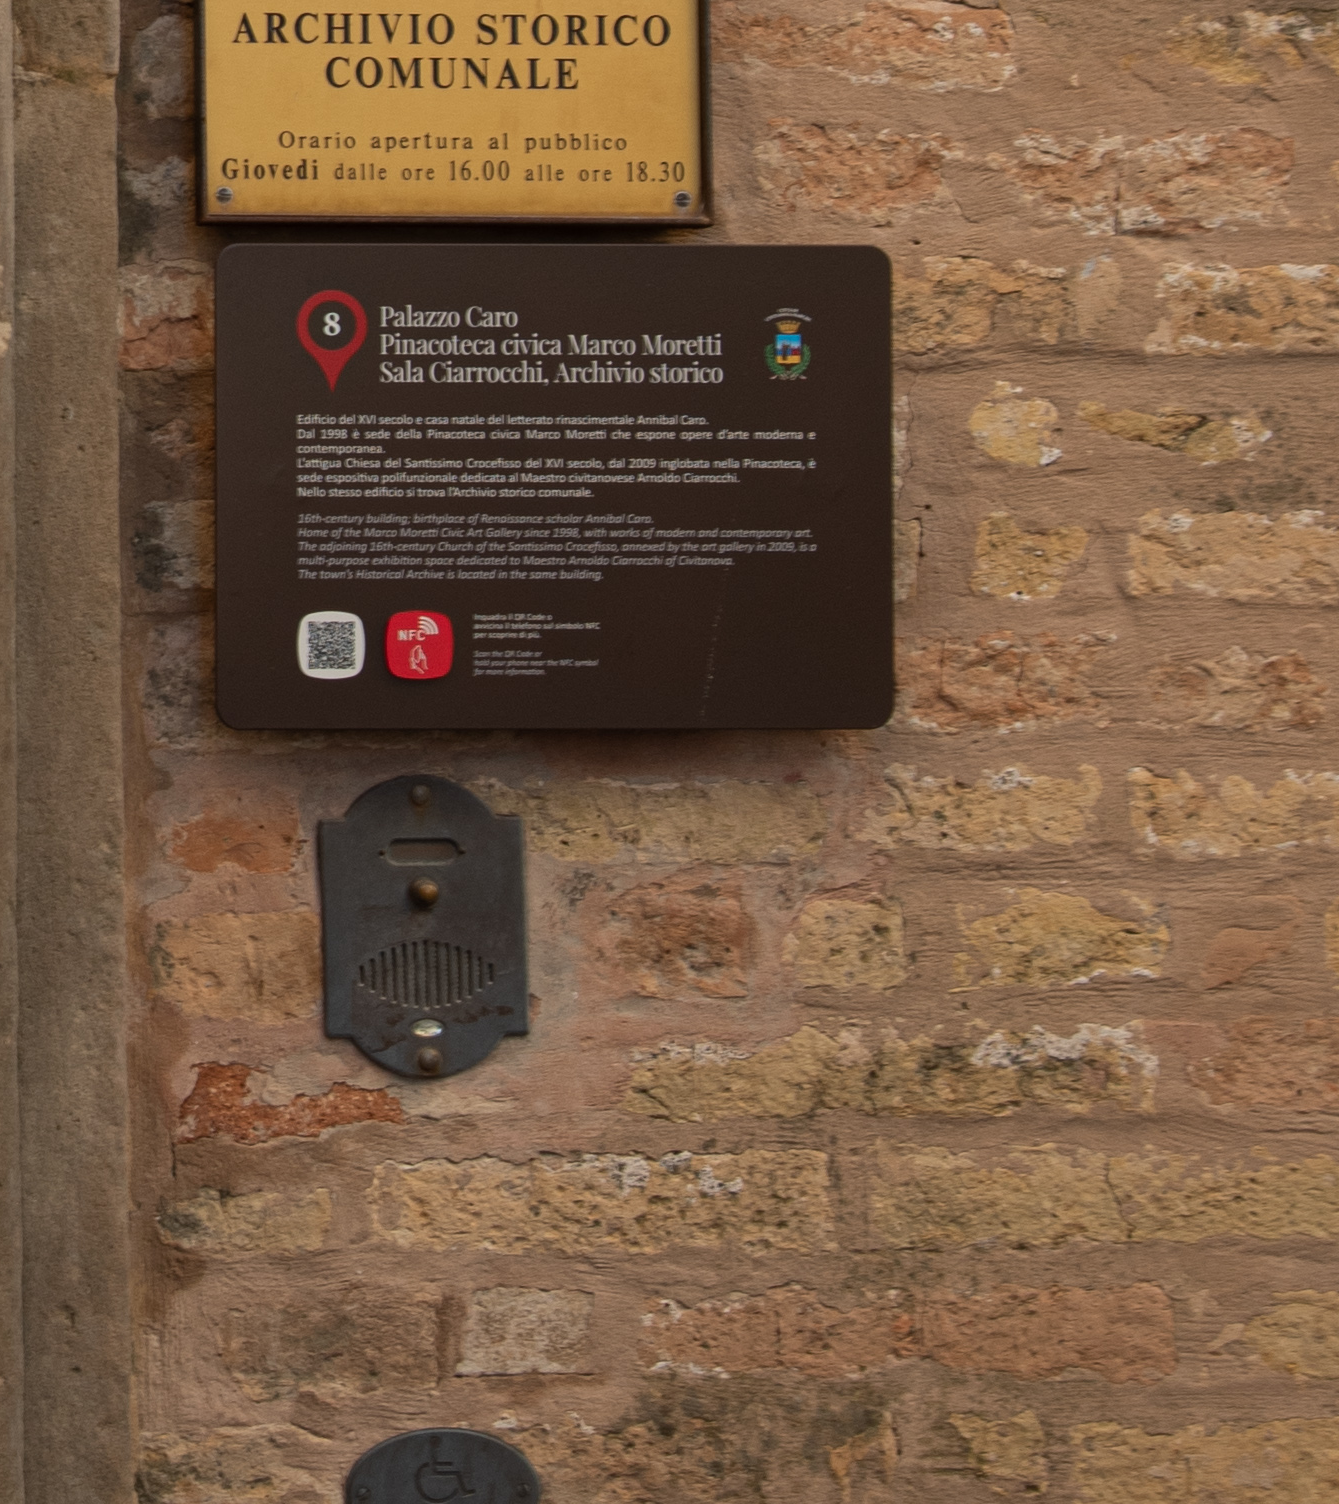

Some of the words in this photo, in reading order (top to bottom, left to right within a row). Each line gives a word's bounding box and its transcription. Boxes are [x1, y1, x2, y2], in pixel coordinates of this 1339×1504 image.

[234, 13, 454, 43] ARCHIVIO
[476, 14, 671, 45] STORICO
[324, 57, 578, 88] COMUNALE
[277, 131, 356, 148] Orario
[370, 133, 473, 153] apertura
[488, 132, 508, 149] al
[524, 133, 627, 153] pubblico
[220, 158, 318, 179] Giovedi
[333, 163, 386, 179] dalle
[401, 168, 434, 180] ore
[449, 160, 510, 180] 16.00
[524, 164, 564, 180] alle
[578, 169, 612, 181] ore
[626, 161, 685, 182] 18.30
[324, 312, 340, 335] 8
[381, 305, 459, 327] Palazzo
[465, 306, 517, 327] Caro
[381, 334, 495, 356] Pinacoteca
[501, 333, 561, 356] civica
[569, 334, 635, 356] Marco
[643, 334, 721, 356] Moretti
[380, 360, 423, 382] Sala
[429, 360, 548, 386] Ciarrocchi,
[556, 360, 644, 382] Archivio
[650, 362, 723, 383] storico
[296, 414, 336, 424] Edificio
[338, 414, 355, 424] del
[357, 414, 376, 424] XVI
[378, 414, 413, 424] secolo
[415, 416, 422, 424] e
[424, 416, 449, 424] casa
[451, 415, 485, 424] natale
[486, 414, 504, 424] del
[506, 415, 553, 424] letterato
[555, 415, 634, 424] rinascimentale
[636, 415, 678, 424] Annibal
[679, 415, 709, 424] Caro.
[296, 428, 315, 438] Dal
[320, 429, 347, 438] 1998
[351, 428, 359, 438] è
[364, 429, 390, 438] sede
[395, 428, 421, 438] della
[426, 429, 485, 438] Pinacoteca
[490, 429, 520, 438] civica
[525, 429, 560, 439] Marco
[565, 429, 606, 439] Moretti
[611, 429, 631, 439] che
[635, 432, 675, 441] espone
[680, 432, 712, 441] opere
[753, 429, 803, 439] moderna
[296, 445, 385, 456] contemporanea.
[344, 458, 380, 468] Chiesa
[383, 458, 401, 468] del
[404, 458, 463, 468] Santissimo
[465, 458, 521, 468] Crocefisso
[524, 458, 541, 468] del
[545, 458, 563, 468] XVI
[566, 458, 604, 470] secolo,
[607, 458, 625, 468] dal
[628, 458, 656, 468] 2009
[659, 458, 709, 471] inglobata
[713, 458, 739, 468] nella
[742, 458, 804, 470] Pinacoteca,
[807, 458, 815, 468] è
[297, 472, 323, 482] sede
[325, 473, 379, 485] espositiva
[381, 472, 457, 485] polifunzionale
[459, 472, 506, 482] dedicata
[508, 472, 518, 482] al
[520, 473, 566, 482] Maestro
[567, 473, 634, 482] civitanovese
[637, 473, 681, 482] Arnoldo
[682, 473, 740, 482] Ciarrocchi.
[296, 486, 326, 496] Nello
[328, 487, 362, 496] stesso
[363, 486, 404, 496] edificio
[405, 487, 415, 496] si
[416, 487, 445, 496] trova
[498, 487, 535, 496] storico
[537, 487, 594, 497] comunale.
[397, 629, 427, 641] NFC
